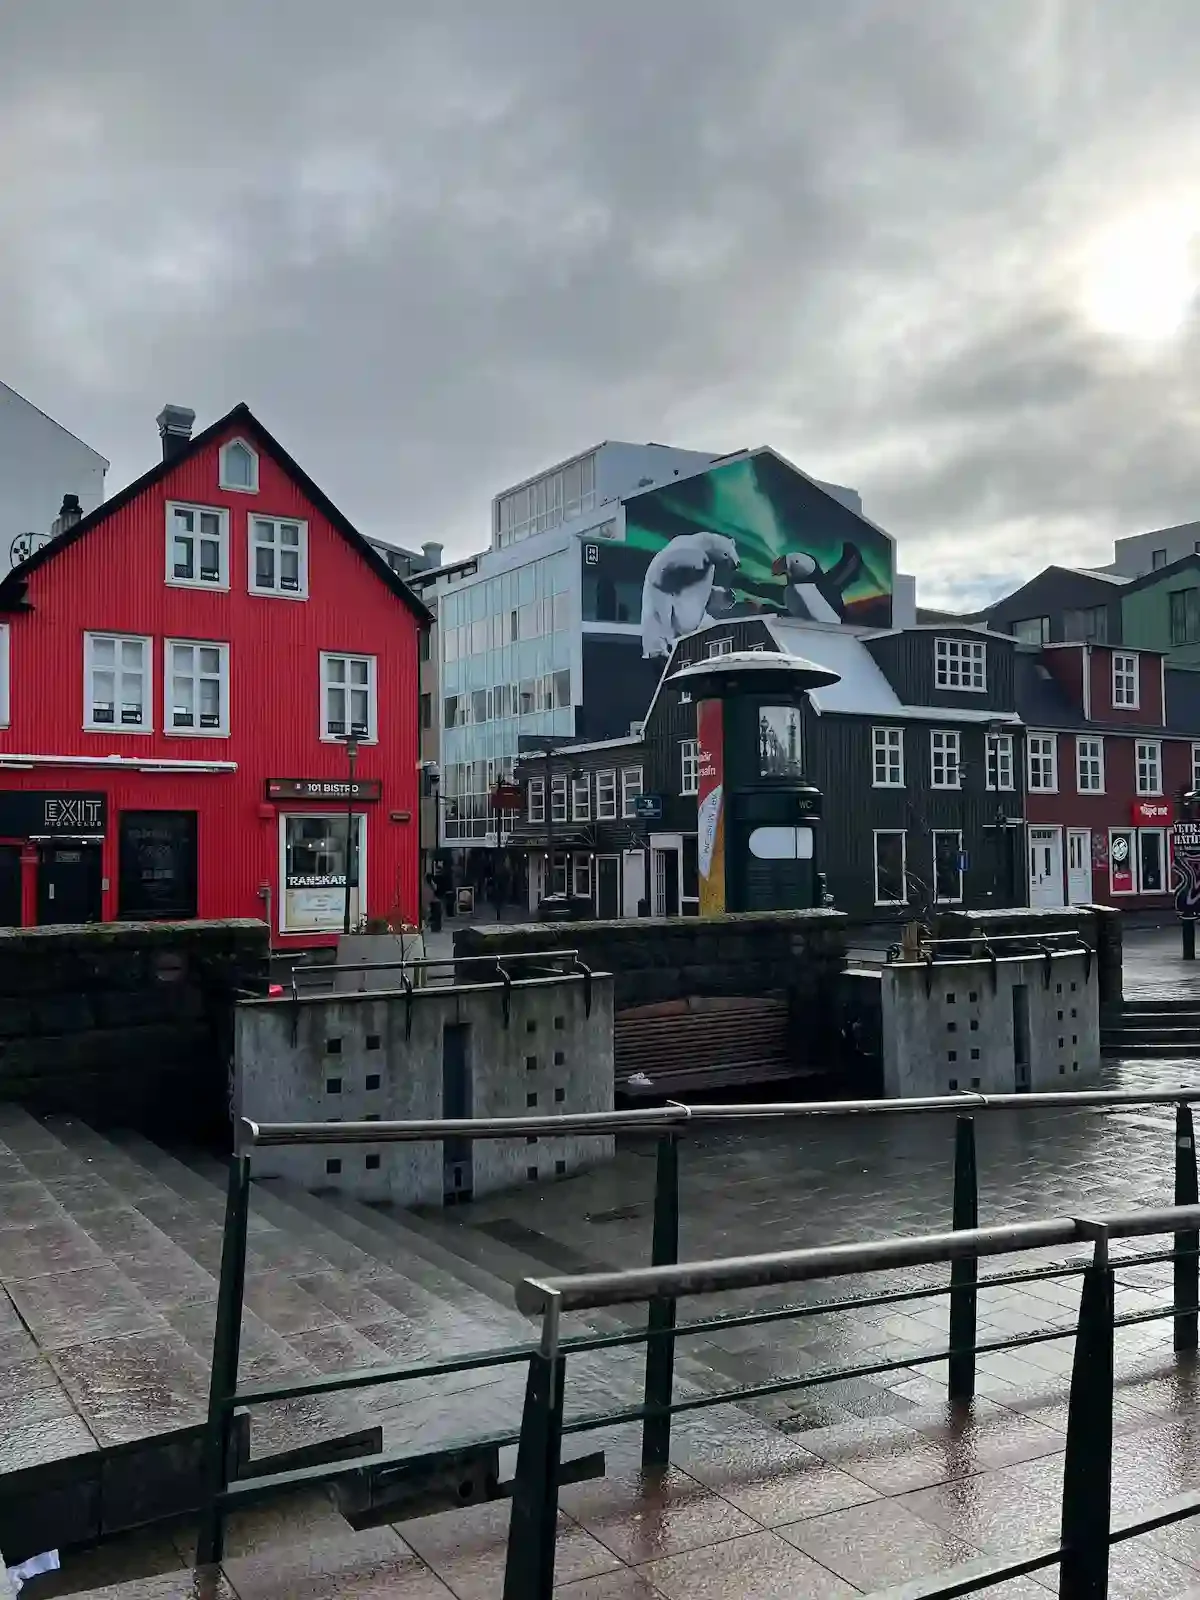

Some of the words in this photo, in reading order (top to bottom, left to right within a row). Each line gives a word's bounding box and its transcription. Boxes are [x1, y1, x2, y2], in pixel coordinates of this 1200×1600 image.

[307, 783, 320, 792] 101
[799, 800, 813, 808] WC
[45, 800, 101, 821] EXIT
[1174, 824, 1200, 833] VETR
[287, 875, 346, 886] RANSKAR
